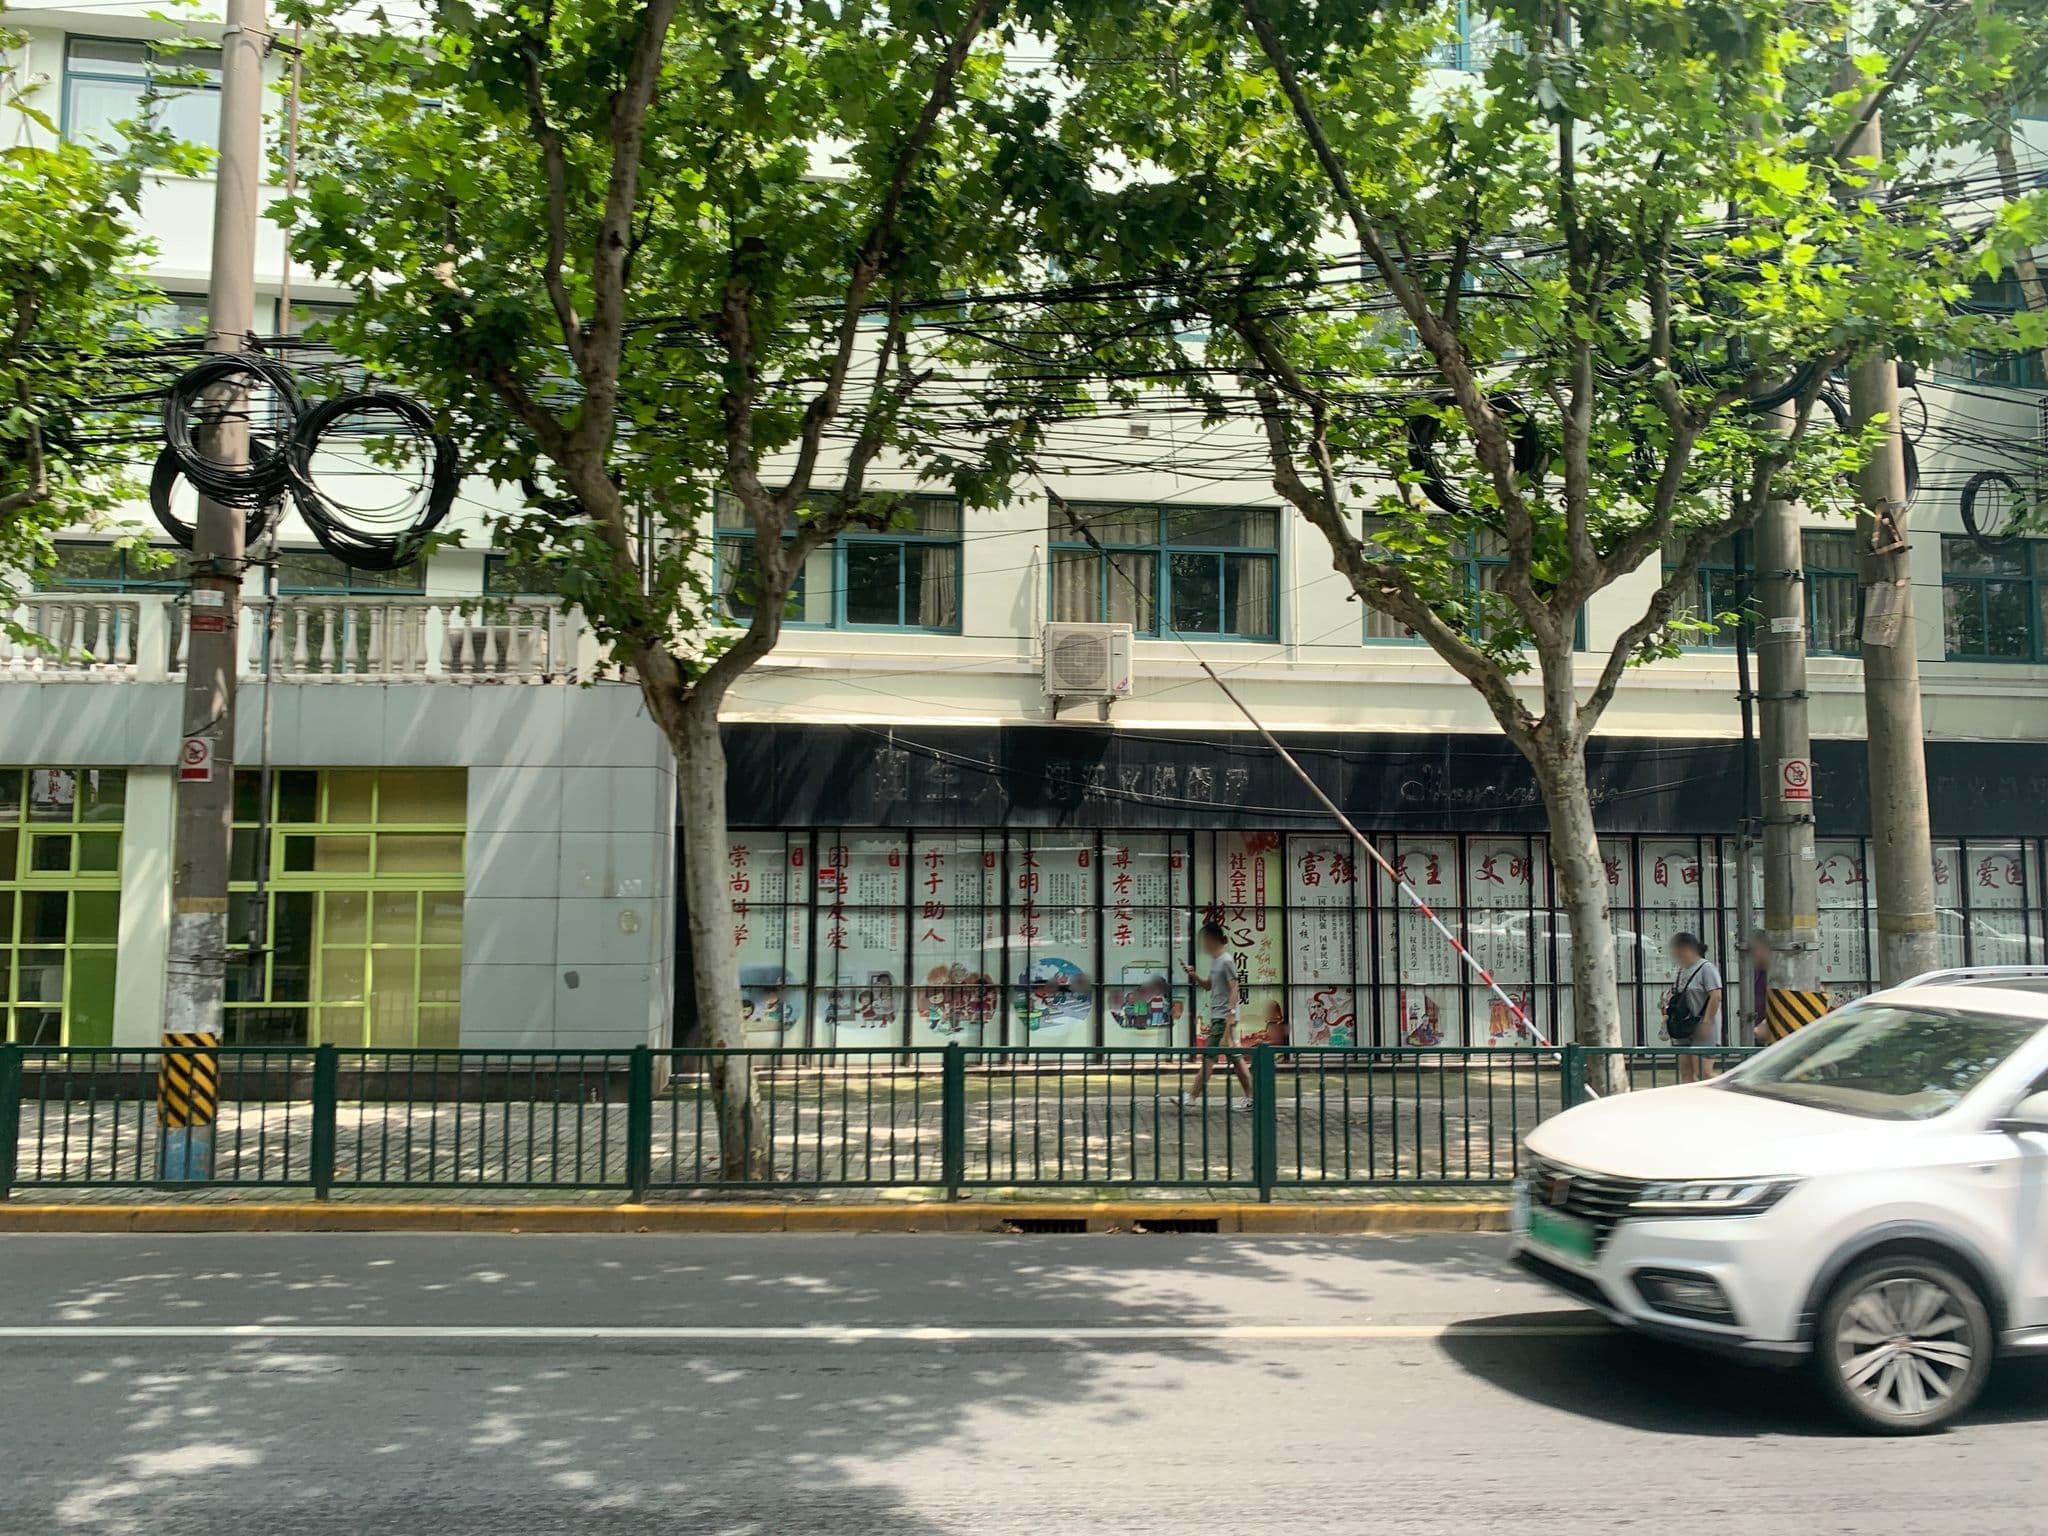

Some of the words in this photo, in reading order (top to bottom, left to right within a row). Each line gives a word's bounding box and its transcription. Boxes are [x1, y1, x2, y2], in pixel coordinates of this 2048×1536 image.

[1297, 851, 1358, 887] 富强
[1390, 854, 1442, 886] 民主
[1474, 854, 1535, 886] 文明
[1654, 856, 1704, 887] 自由
[1815, 859, 1869, 886] 公正
[921, 847, 946, 942] 乐于助人
[1018, 850, 1041, 945] 文明礼貌
[1112, 847, 1133, 946] 尊老爱亲
[1230, 853, 1247, 922] 社会主义
